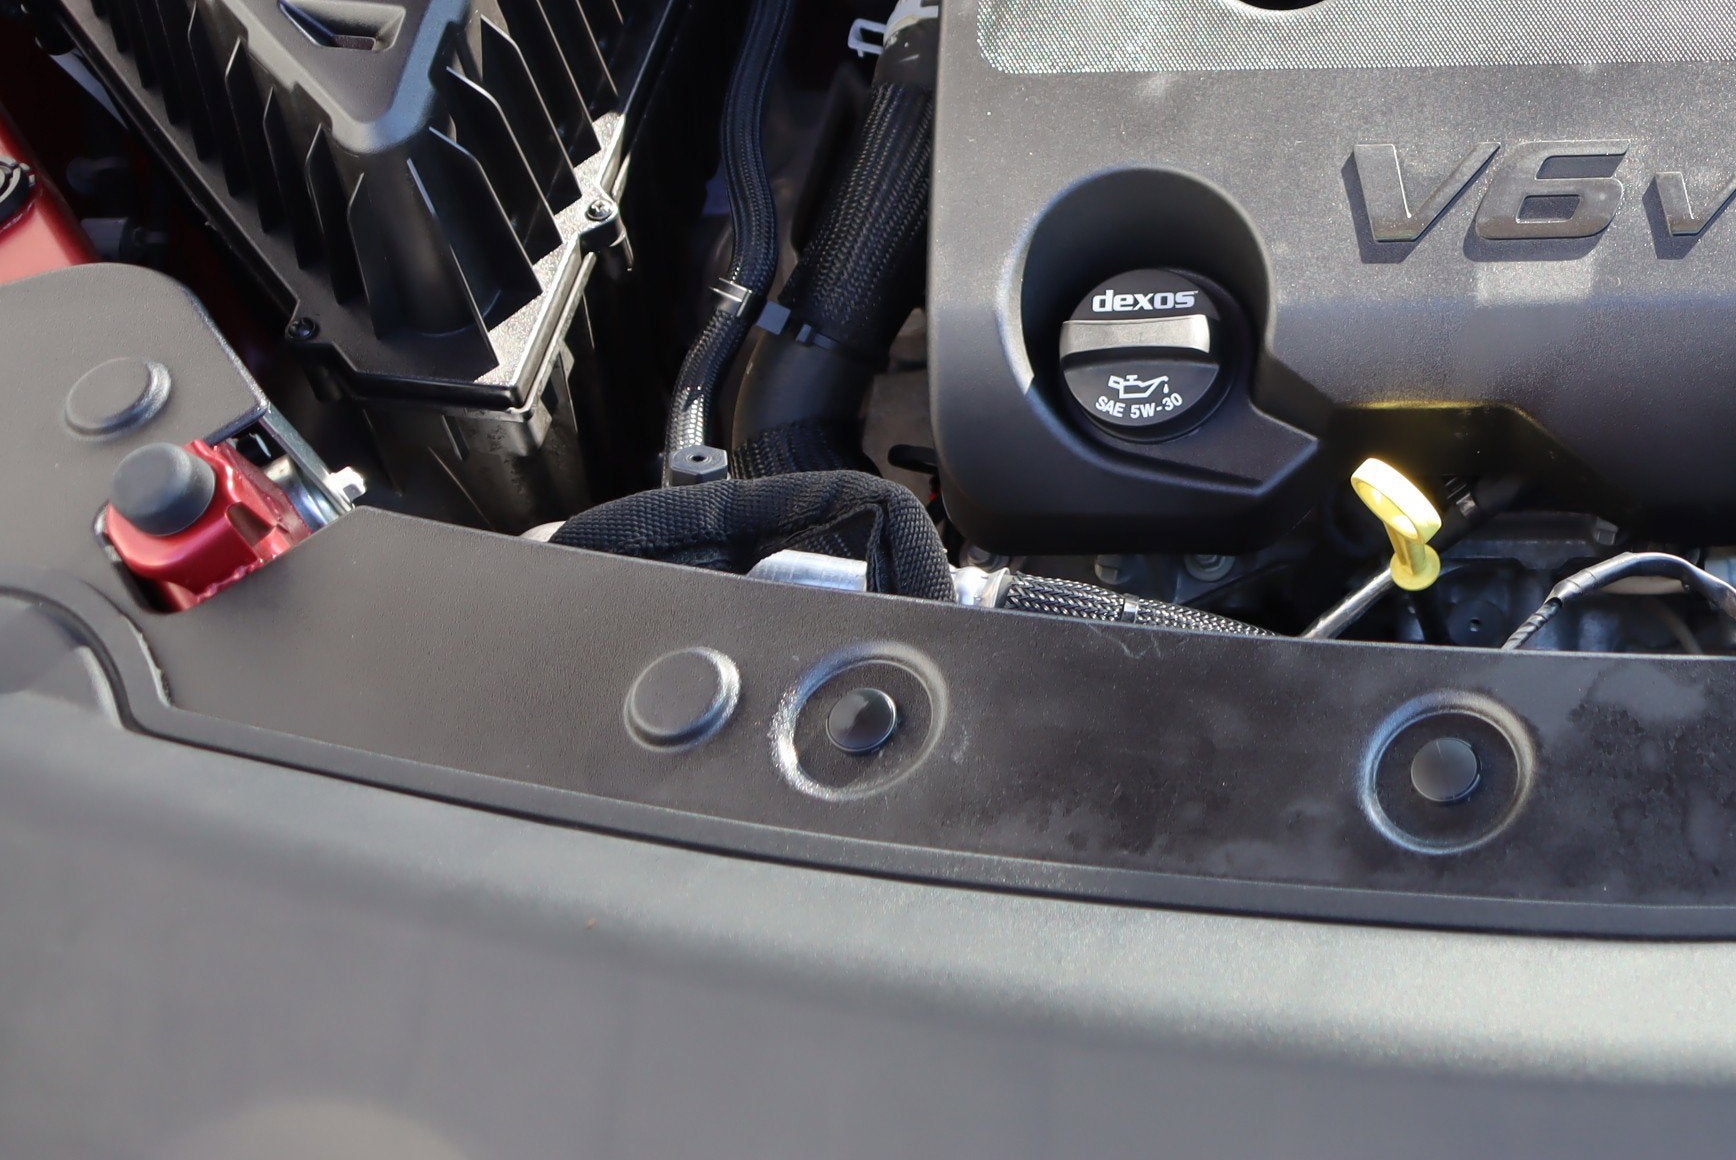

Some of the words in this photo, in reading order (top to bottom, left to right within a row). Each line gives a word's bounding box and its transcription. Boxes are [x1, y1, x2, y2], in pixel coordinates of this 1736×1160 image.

[1346, 139, 1630, 248] V6
[1092, 289, 1197, 313] dexos
[1095, 395, 1125, 418] SAE
[1130, 392, 1183, 419] 5W-30
